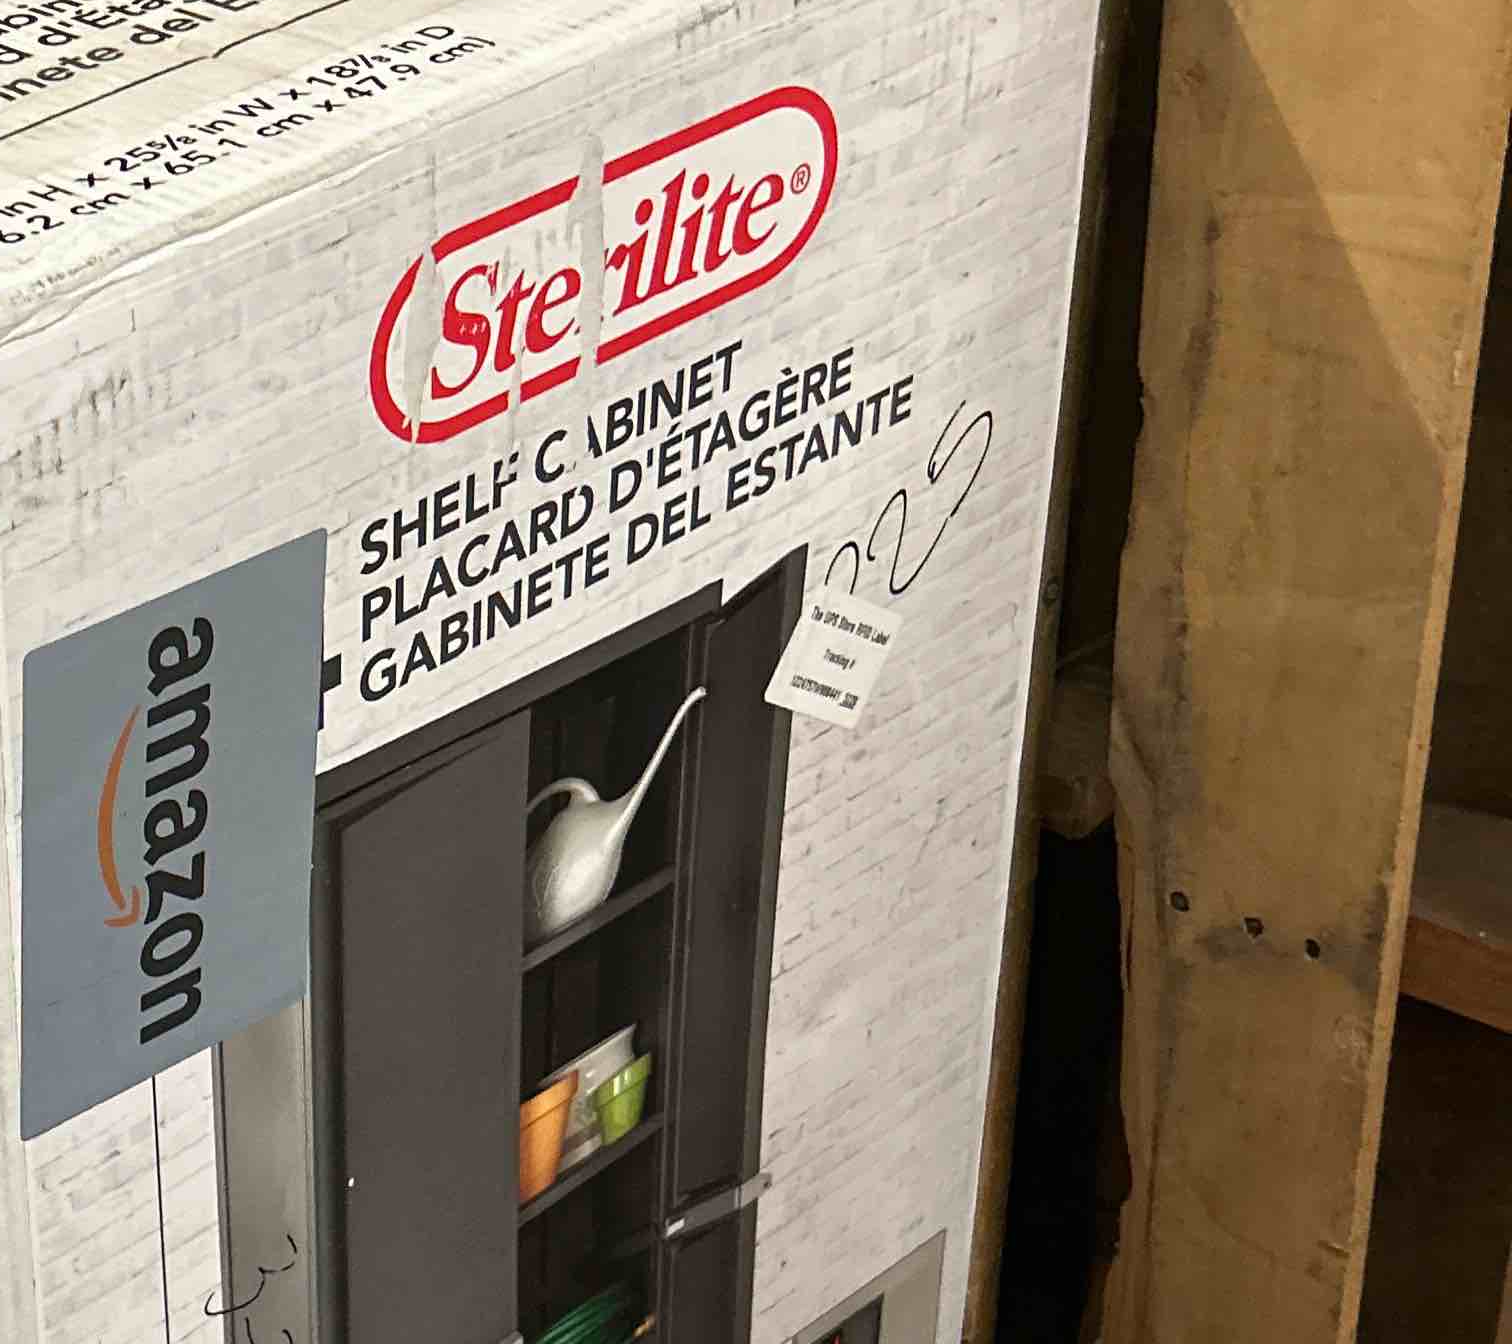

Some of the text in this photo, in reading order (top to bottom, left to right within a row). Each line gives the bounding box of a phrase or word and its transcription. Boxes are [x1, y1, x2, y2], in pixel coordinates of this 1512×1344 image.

[28, 182, 75, 205] H
[74, 170, 100, 189] x
[190, 113, 227, 138] in
[222, 97, 274, 120] W
[275, 86, 303, 102] x
[382, 34, 420, 57] in
[417, 24, 457, 41] D
[128, 8, 212, 47] del
[70, 190, 131, 217] cm
[131, 176, 168, 191] x
[164, 137, 249, 178] 65.1
[255, 112, 317, 139] cm
[312, 96, 346, 114] x
[342, 62, 422, 101] 47.9
[428, 36, 500, 68] cm)
[358, 535, 611, 703] GABINETE
[626, 490, 712, 565] DEL
[724, 374, 915, 511] ESTANTE
[359, 345, 855, 643] PLACARD D'ÉTAGÈRE
[359, 452, 520, 577] SHELF
[140, 616, 215, 1045] amazon
